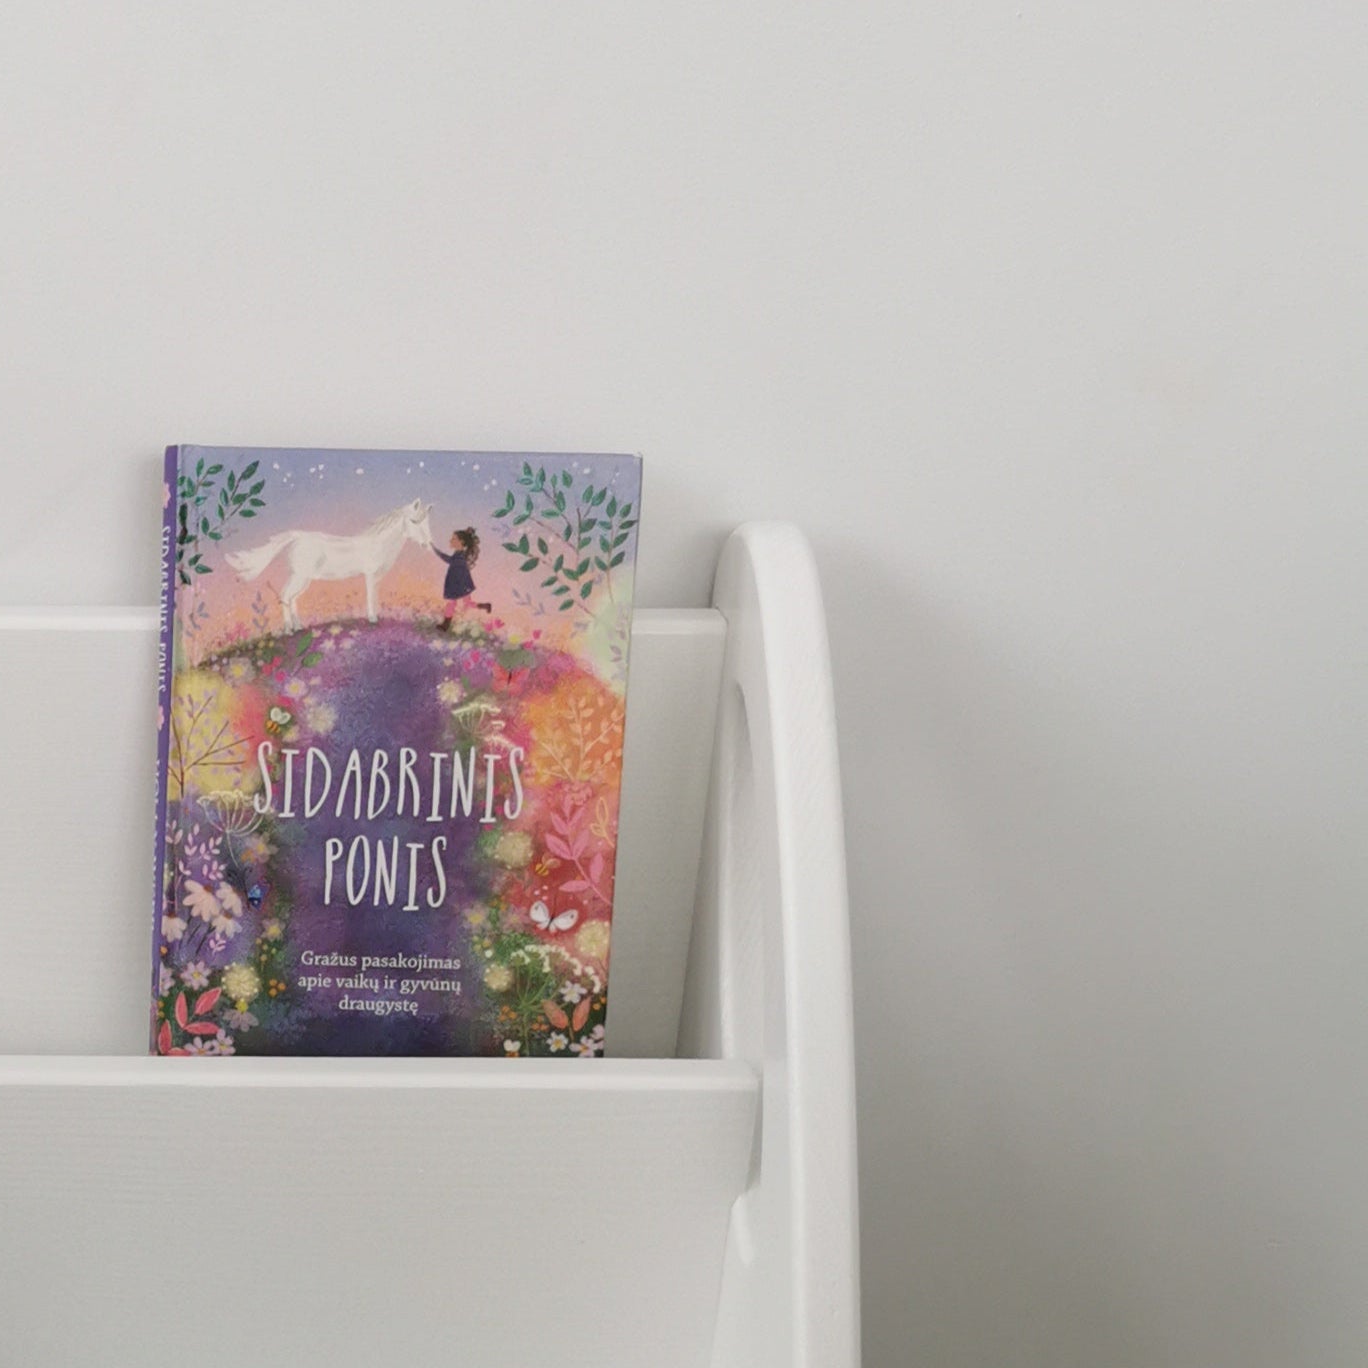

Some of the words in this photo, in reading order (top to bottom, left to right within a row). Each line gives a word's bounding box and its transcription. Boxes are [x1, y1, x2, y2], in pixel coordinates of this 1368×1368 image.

[253, 741, 524, 823] SIDABRINIS
[324, 835, 447, 911] PONIS
[300, 950, 357, 966] Gražus
[361, 953, 461, 972] pasakojimas
[297, 974, 331, 991] apie
[336, 974, 379, 993] vaikų
[383, 975, 396, 988] ir
[399, 978, 462, 995] gyvūnų
[338, 995, 419, 1016] draugystę
